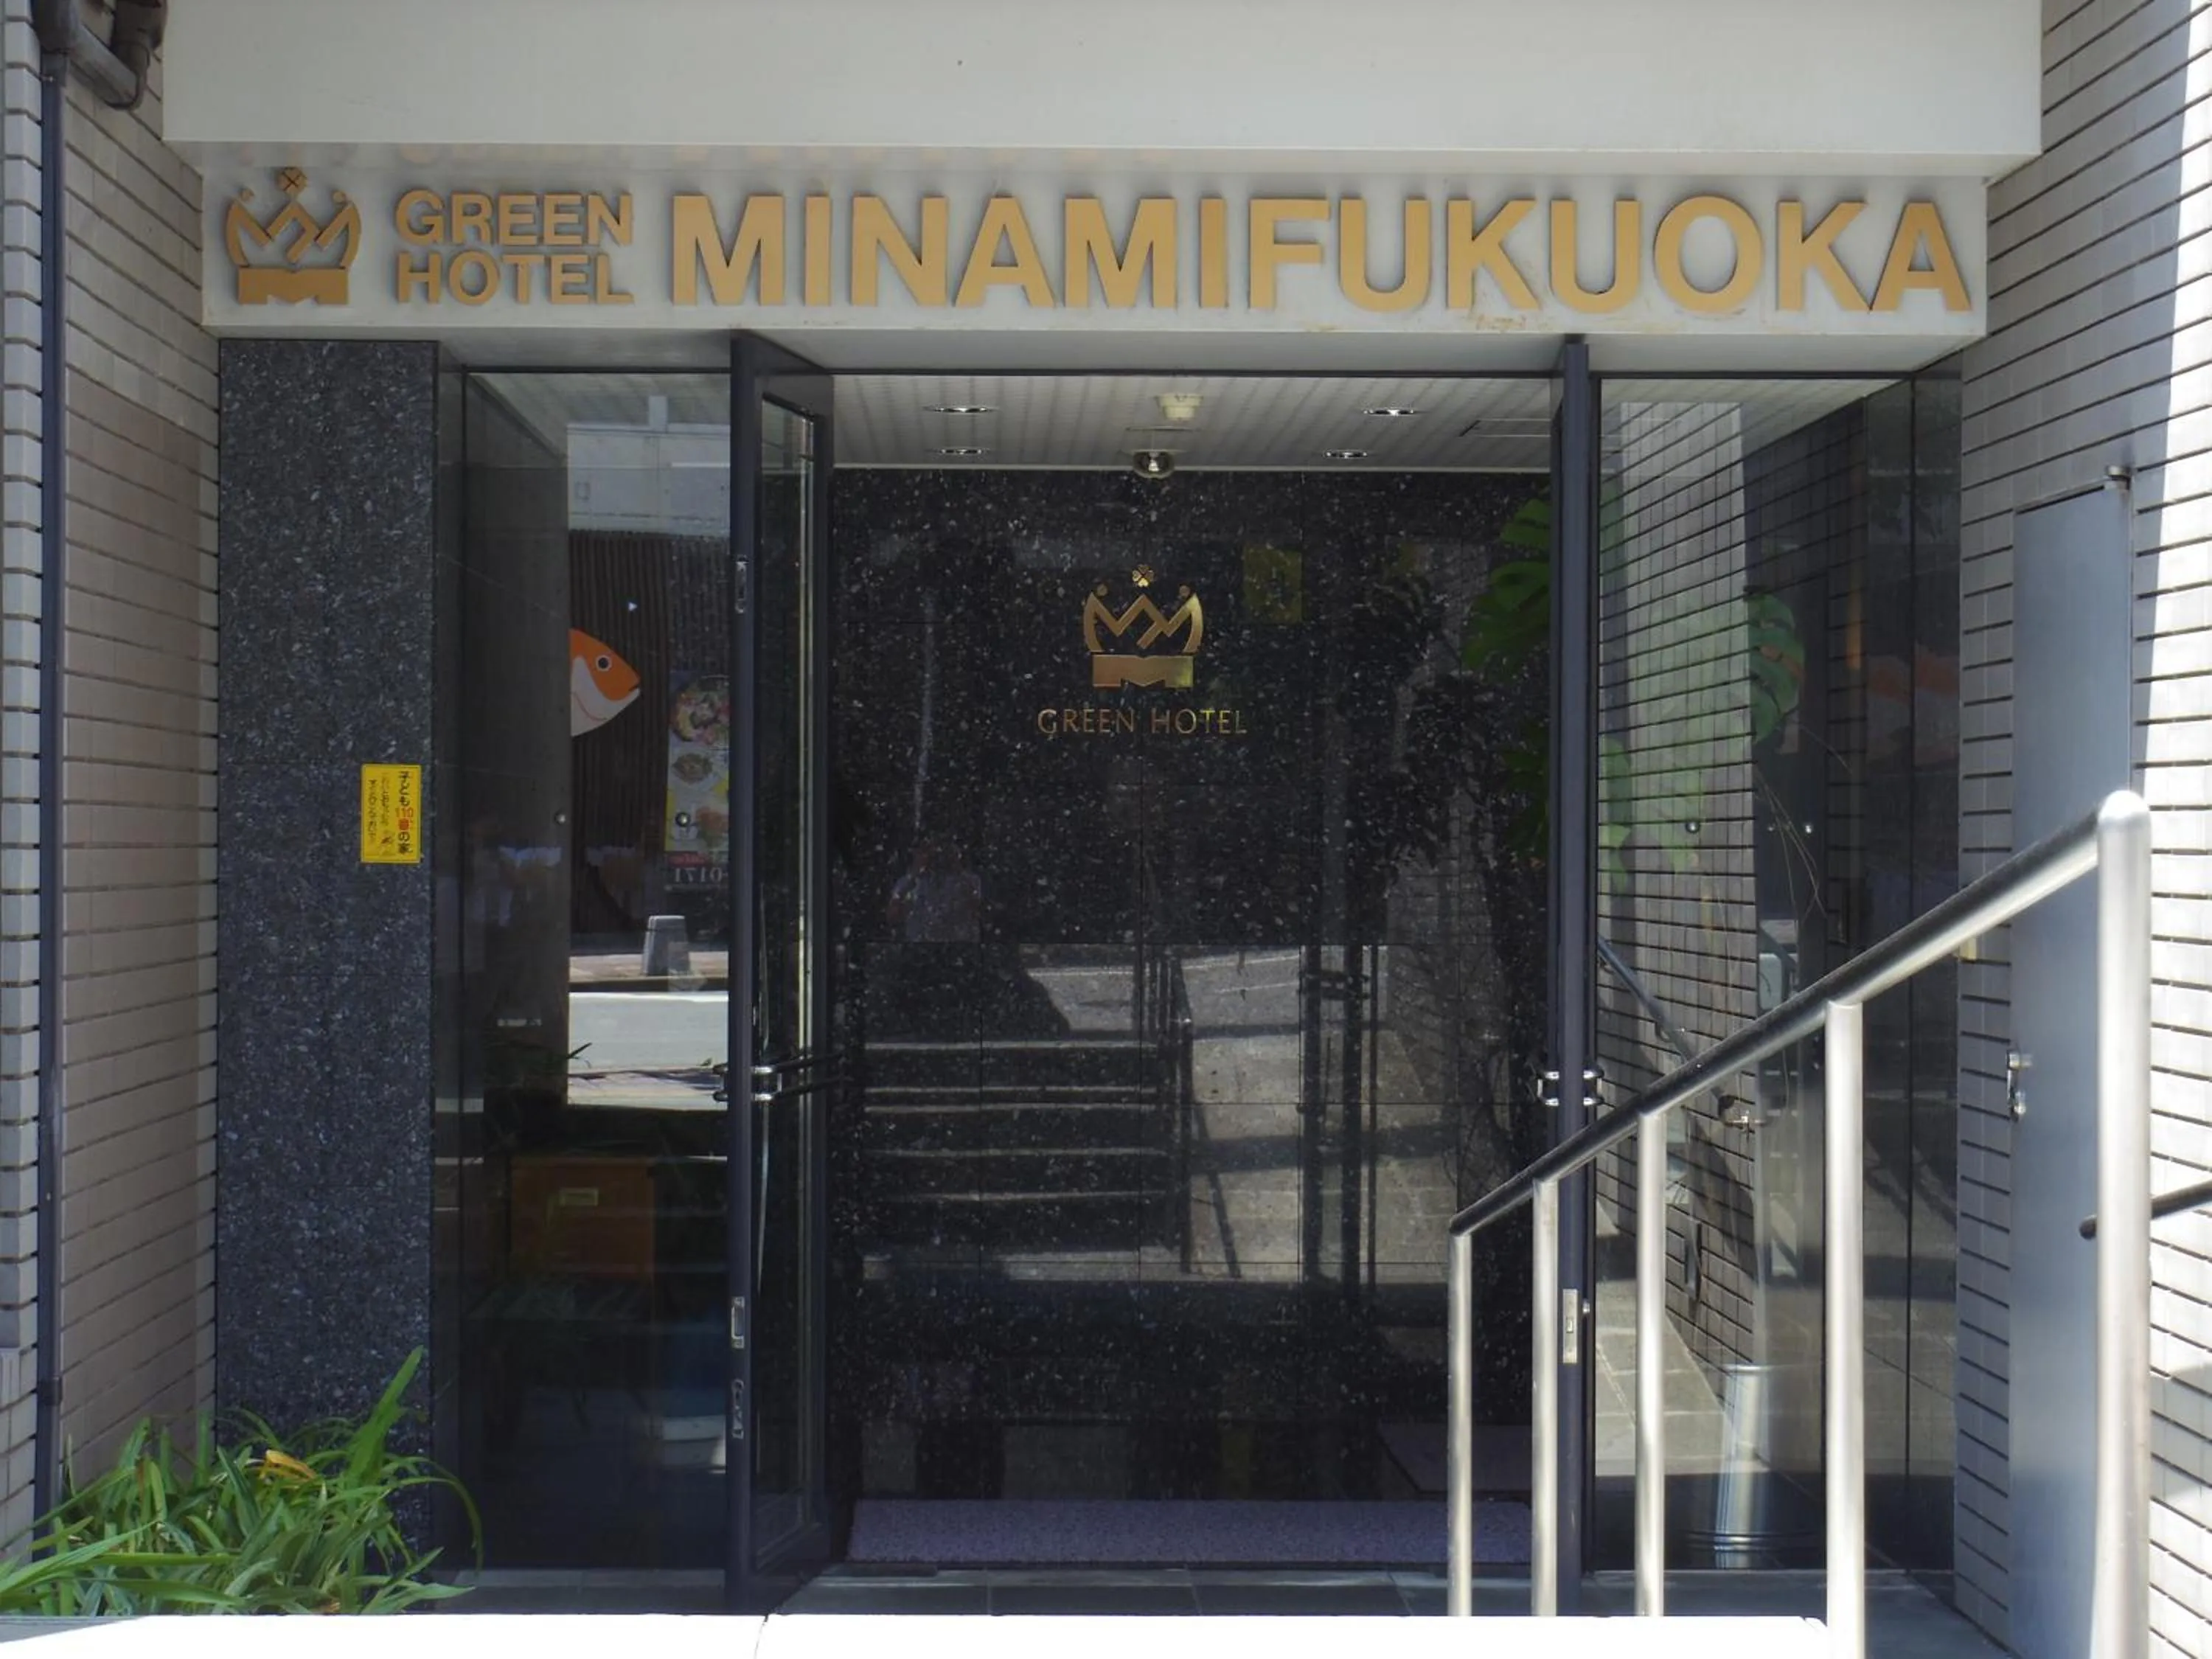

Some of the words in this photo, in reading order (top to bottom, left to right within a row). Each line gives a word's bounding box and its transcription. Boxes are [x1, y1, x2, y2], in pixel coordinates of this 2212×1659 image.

[395, 189, 633, 246] GREEN
[396, 249, 634, 305] HOTEL
[672, 195, 1973, 313] MINAMIFUKUOKA
[1037, 708, 1135, 734] GREEN
[1150, 708, 1248, 734] HOTEL
